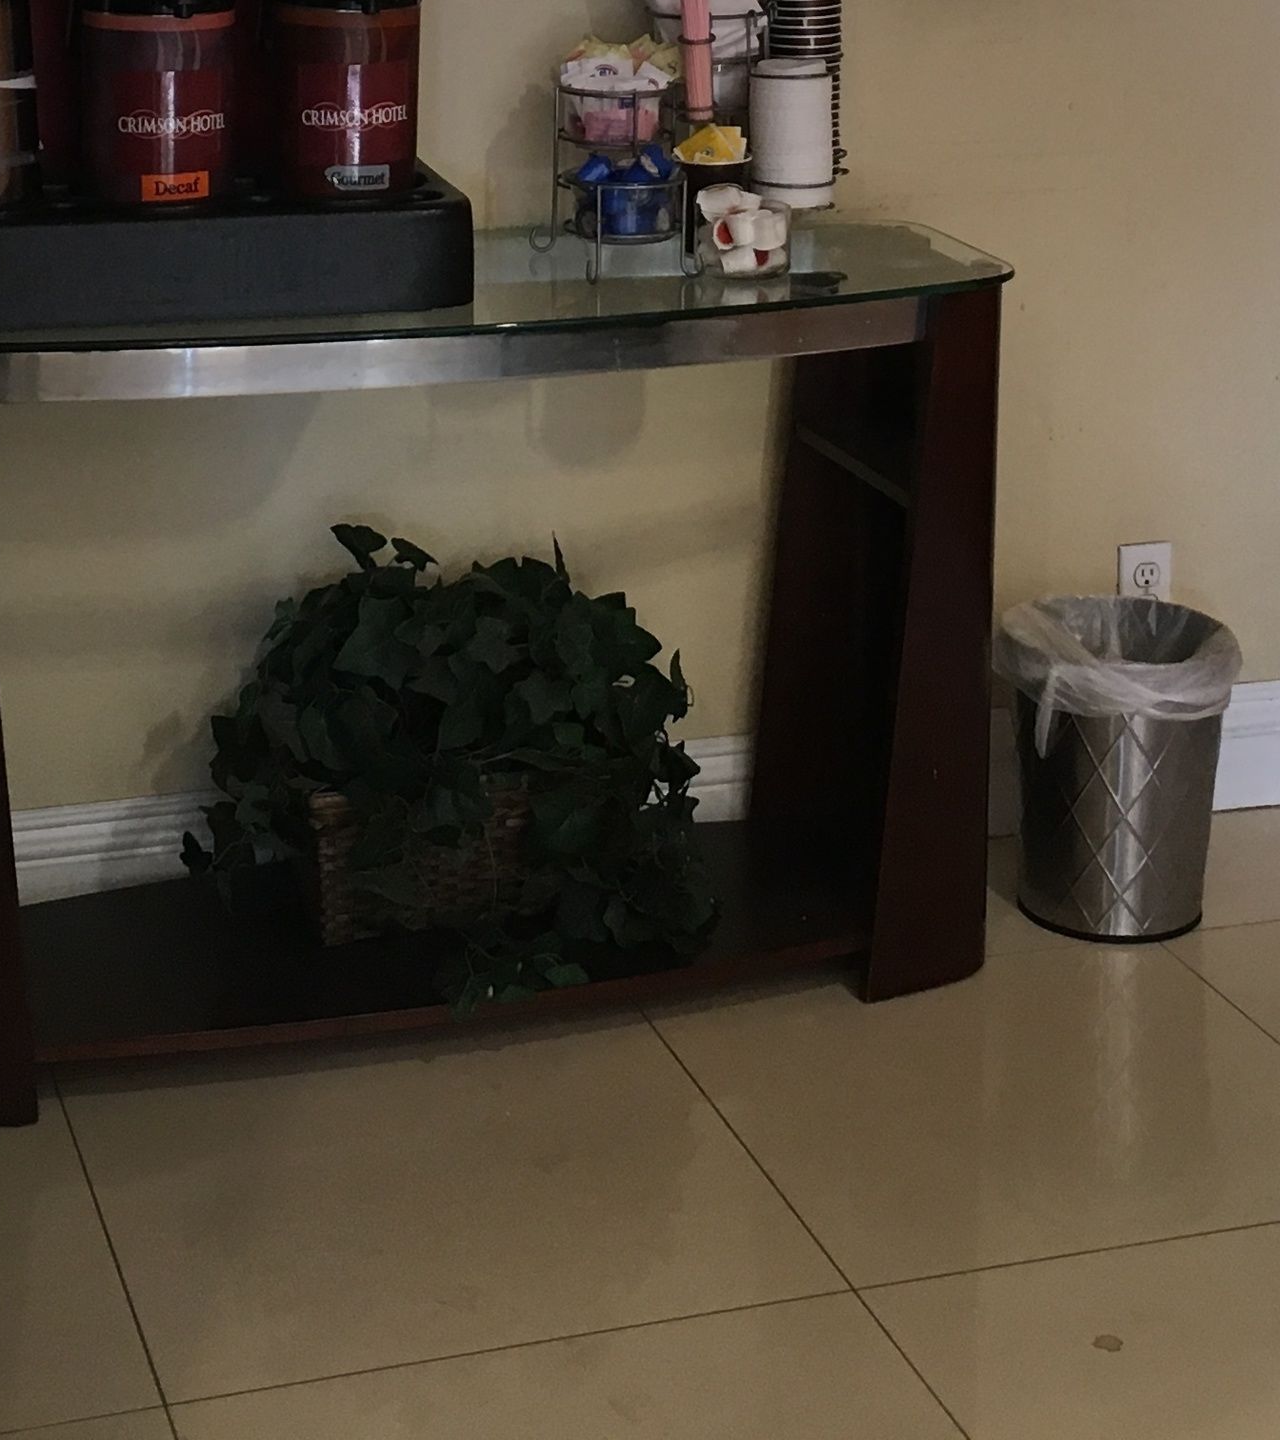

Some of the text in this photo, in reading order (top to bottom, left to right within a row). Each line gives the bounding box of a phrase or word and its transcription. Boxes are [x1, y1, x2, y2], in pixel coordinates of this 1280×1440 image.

[118, 113, 225, 134] CRIMSON HOTEL
[302, 105, 407, 126] CRIMSON HOTEL
[154, 176, 200, 196] Decaf
[331, 171, 385, 186] Gourmet
